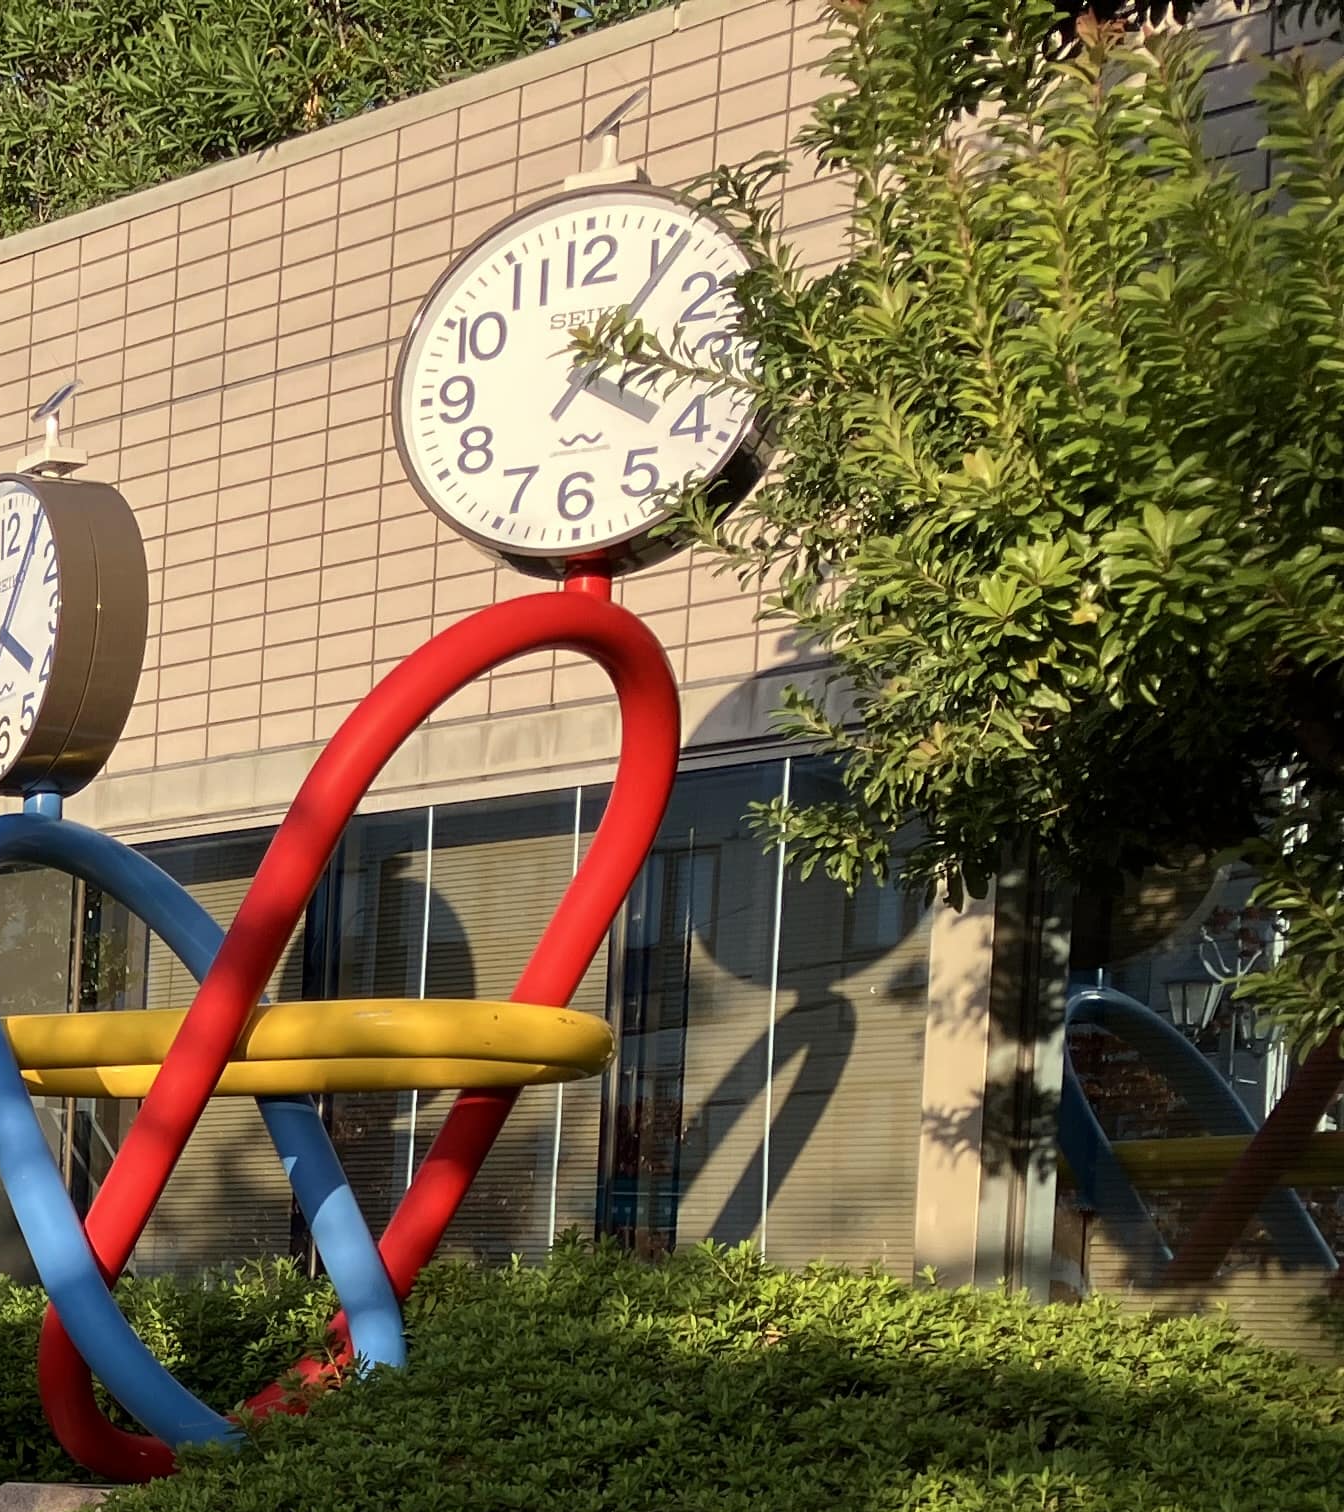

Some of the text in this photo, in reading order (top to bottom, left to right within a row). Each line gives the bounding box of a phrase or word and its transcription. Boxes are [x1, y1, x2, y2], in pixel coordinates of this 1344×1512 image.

[512, 258, 550, 311] 11
[566, 234, 618, 288] 12
[680, 271, 716, 324] 2
[458, 311, 507, 364] 10
[439, 375, 476, 424] 9
[669, 394, 711, 443] 4
[457, 426, 494, 474] 8
[620, 446, 660, 498] 5
[502, 465, 540, 514] 7
[556, 472, 595, 521] 6
[0, 512, 21, 561] 12
[43, 538, 59, 586] 2
[20, 691, 36, 737] 5
